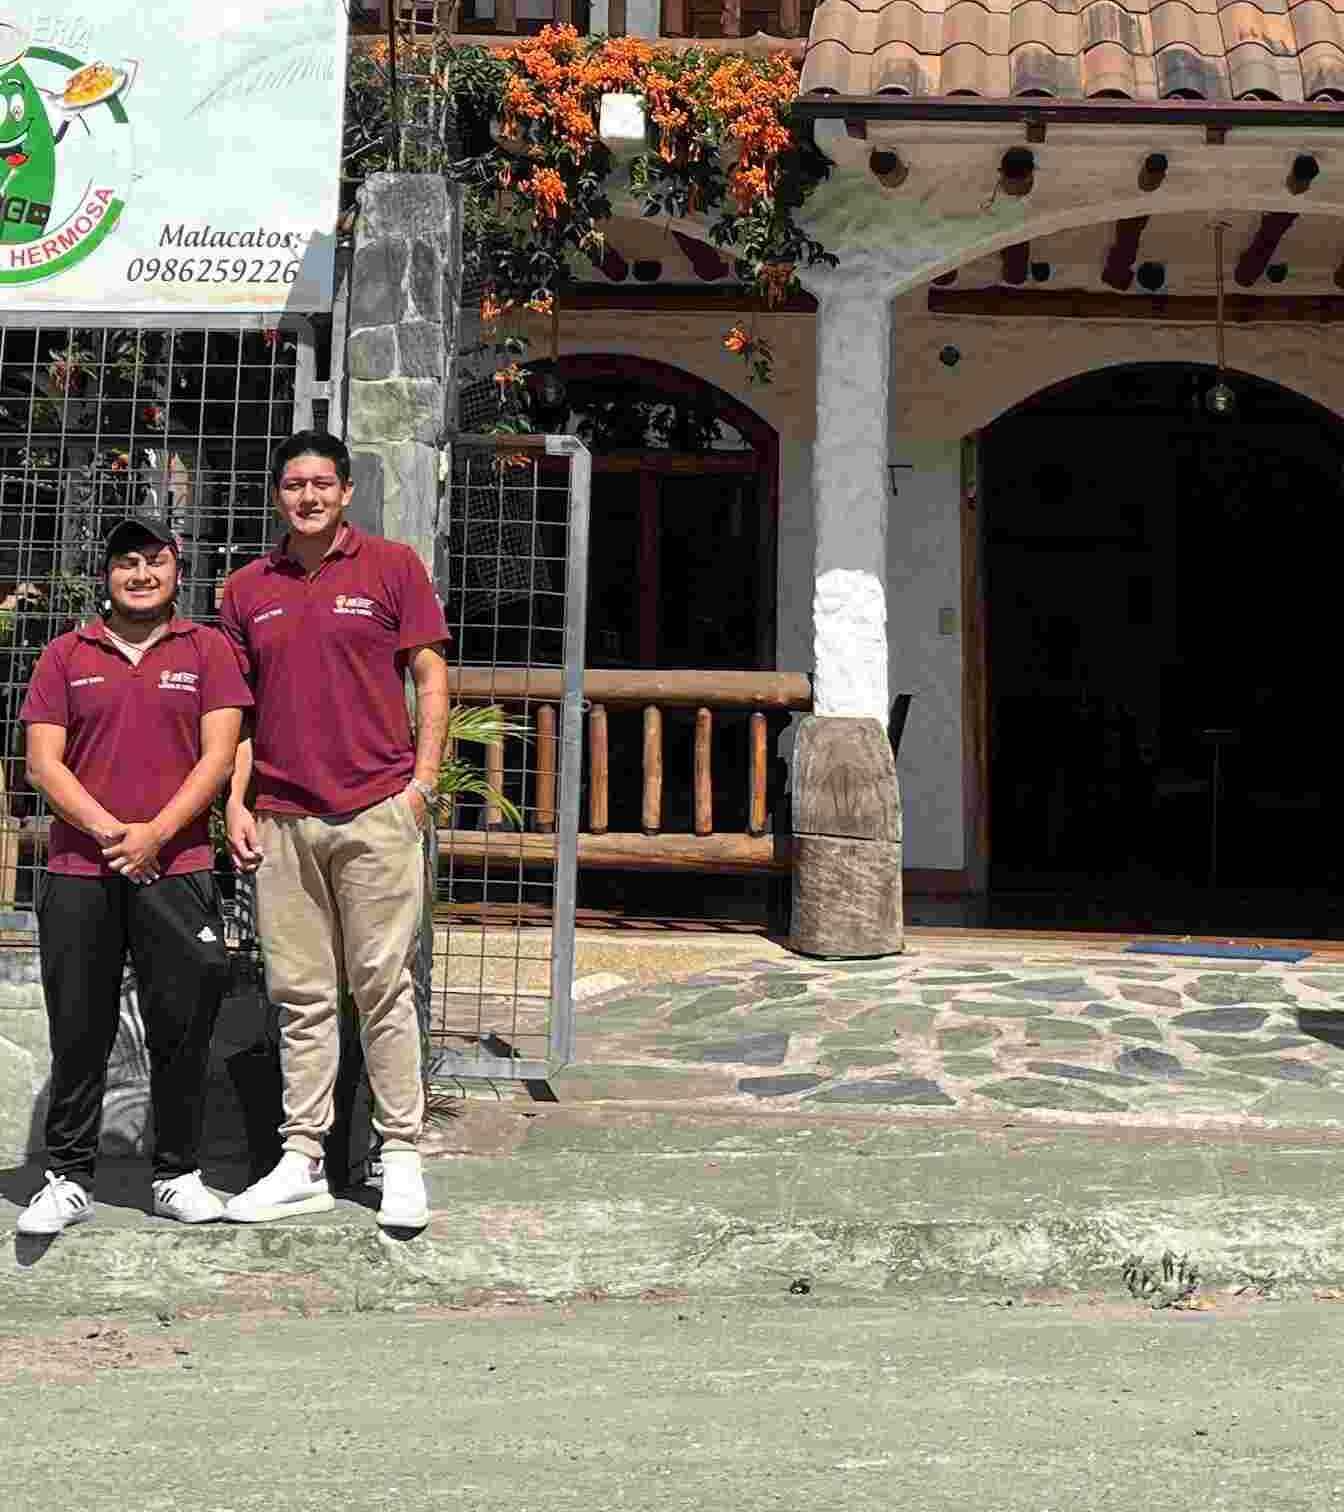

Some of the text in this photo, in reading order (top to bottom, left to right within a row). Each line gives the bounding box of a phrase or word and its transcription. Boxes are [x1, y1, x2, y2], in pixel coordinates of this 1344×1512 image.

[9, 189, 114, 268] HERMOSA
[158, 224, 299, 249] Malacatos:
[126, 257, 301, 284] 0986259226
